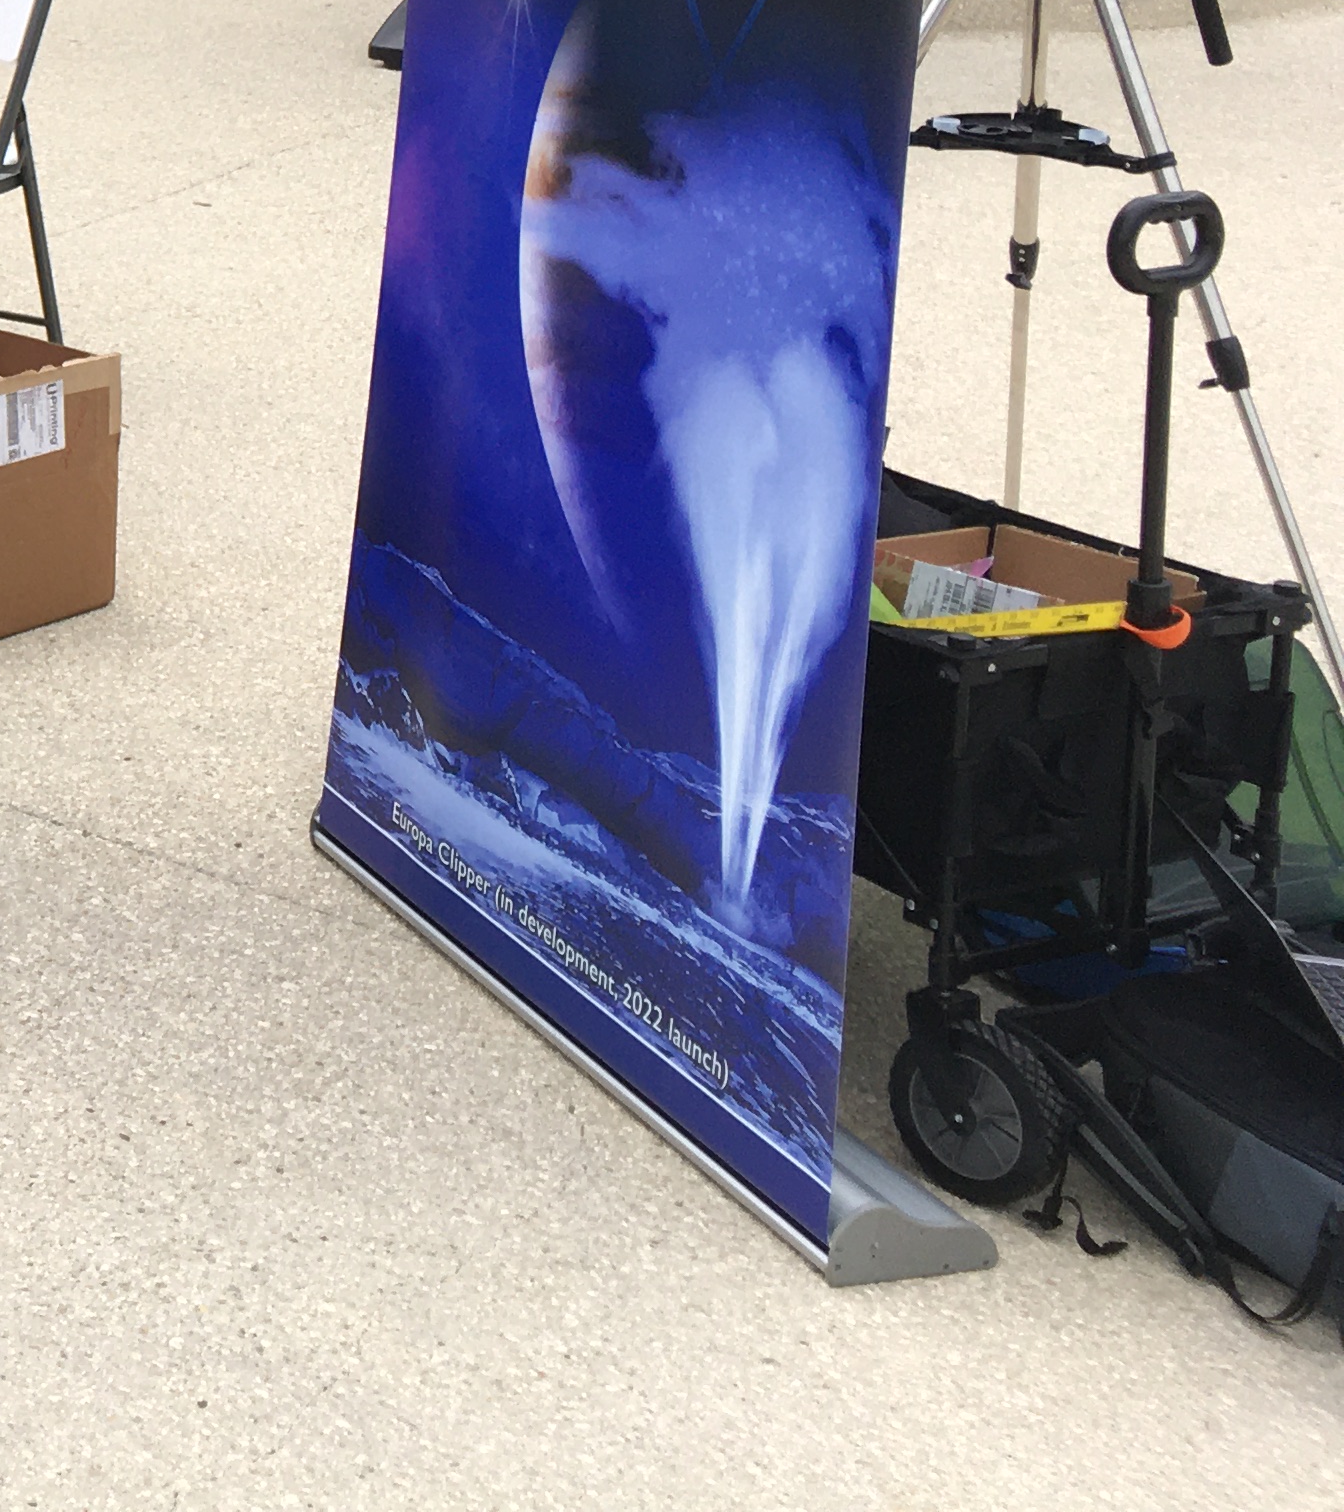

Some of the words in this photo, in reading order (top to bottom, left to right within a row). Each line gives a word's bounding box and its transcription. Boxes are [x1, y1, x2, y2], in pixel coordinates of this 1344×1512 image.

[392, 801, 434, 855] Europa
[438, 841, 492, 895] Clipper
[494, 883, 514, 916] (in
[518, 904, 619, 1001] development,
[622, 982, 664, 1033] 2022
[668, 1017, 730, 1090] launch)
